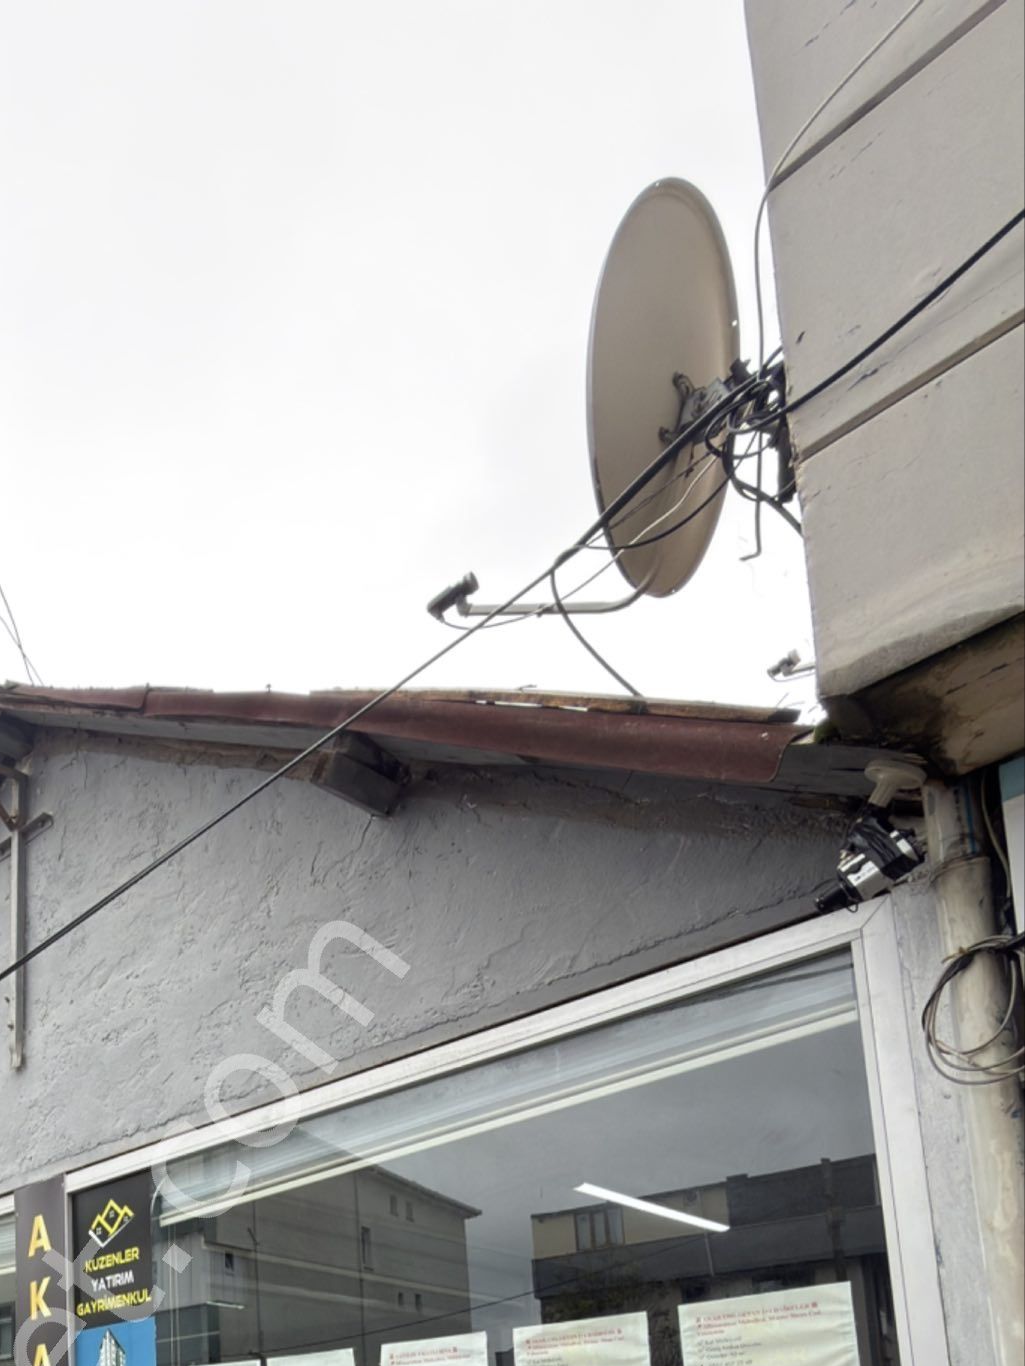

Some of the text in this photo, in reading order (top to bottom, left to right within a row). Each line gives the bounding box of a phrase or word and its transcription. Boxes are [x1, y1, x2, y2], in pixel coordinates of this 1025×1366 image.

[84, 1246, 140, 1273] KUZENLER
[91, 1269, 135, 1292] YATIRIM
[76, 1288, 152, 1317] GAYRİMENKUL
